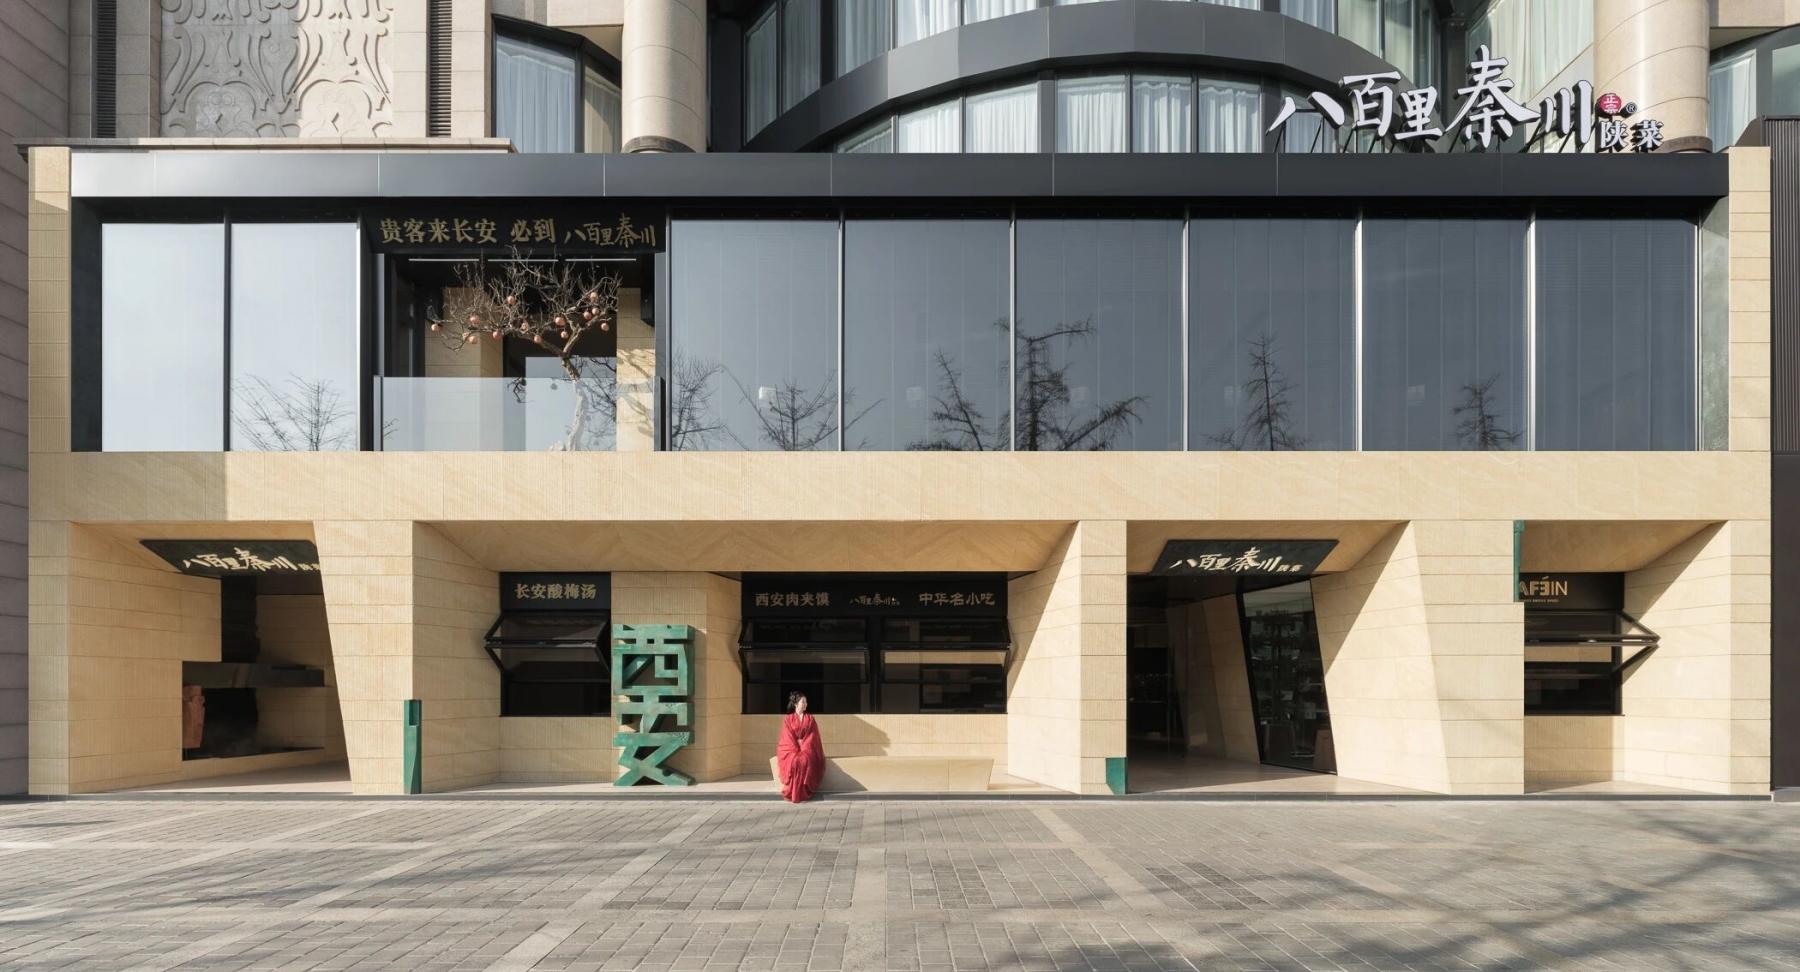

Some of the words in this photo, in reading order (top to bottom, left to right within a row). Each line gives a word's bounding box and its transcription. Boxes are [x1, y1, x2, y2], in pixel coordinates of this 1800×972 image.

[1266, 44, 1594, 148] 八百里秦川
[1600, 120, 1664, 149] 陕菜
[379, 218, 498, 244] 贵客来长安
[510, 218, 556, 244] 必到
[564, 213, 657, 248] 八百里秦川
[1169, 546, 1283, 573] 八百里秦川
[514, 583, 597, 600] 长安酸梅汤
[755, 592, 830, 607] 西安肉夹馍
[918, 591, 996, 607] 中华名小吃
